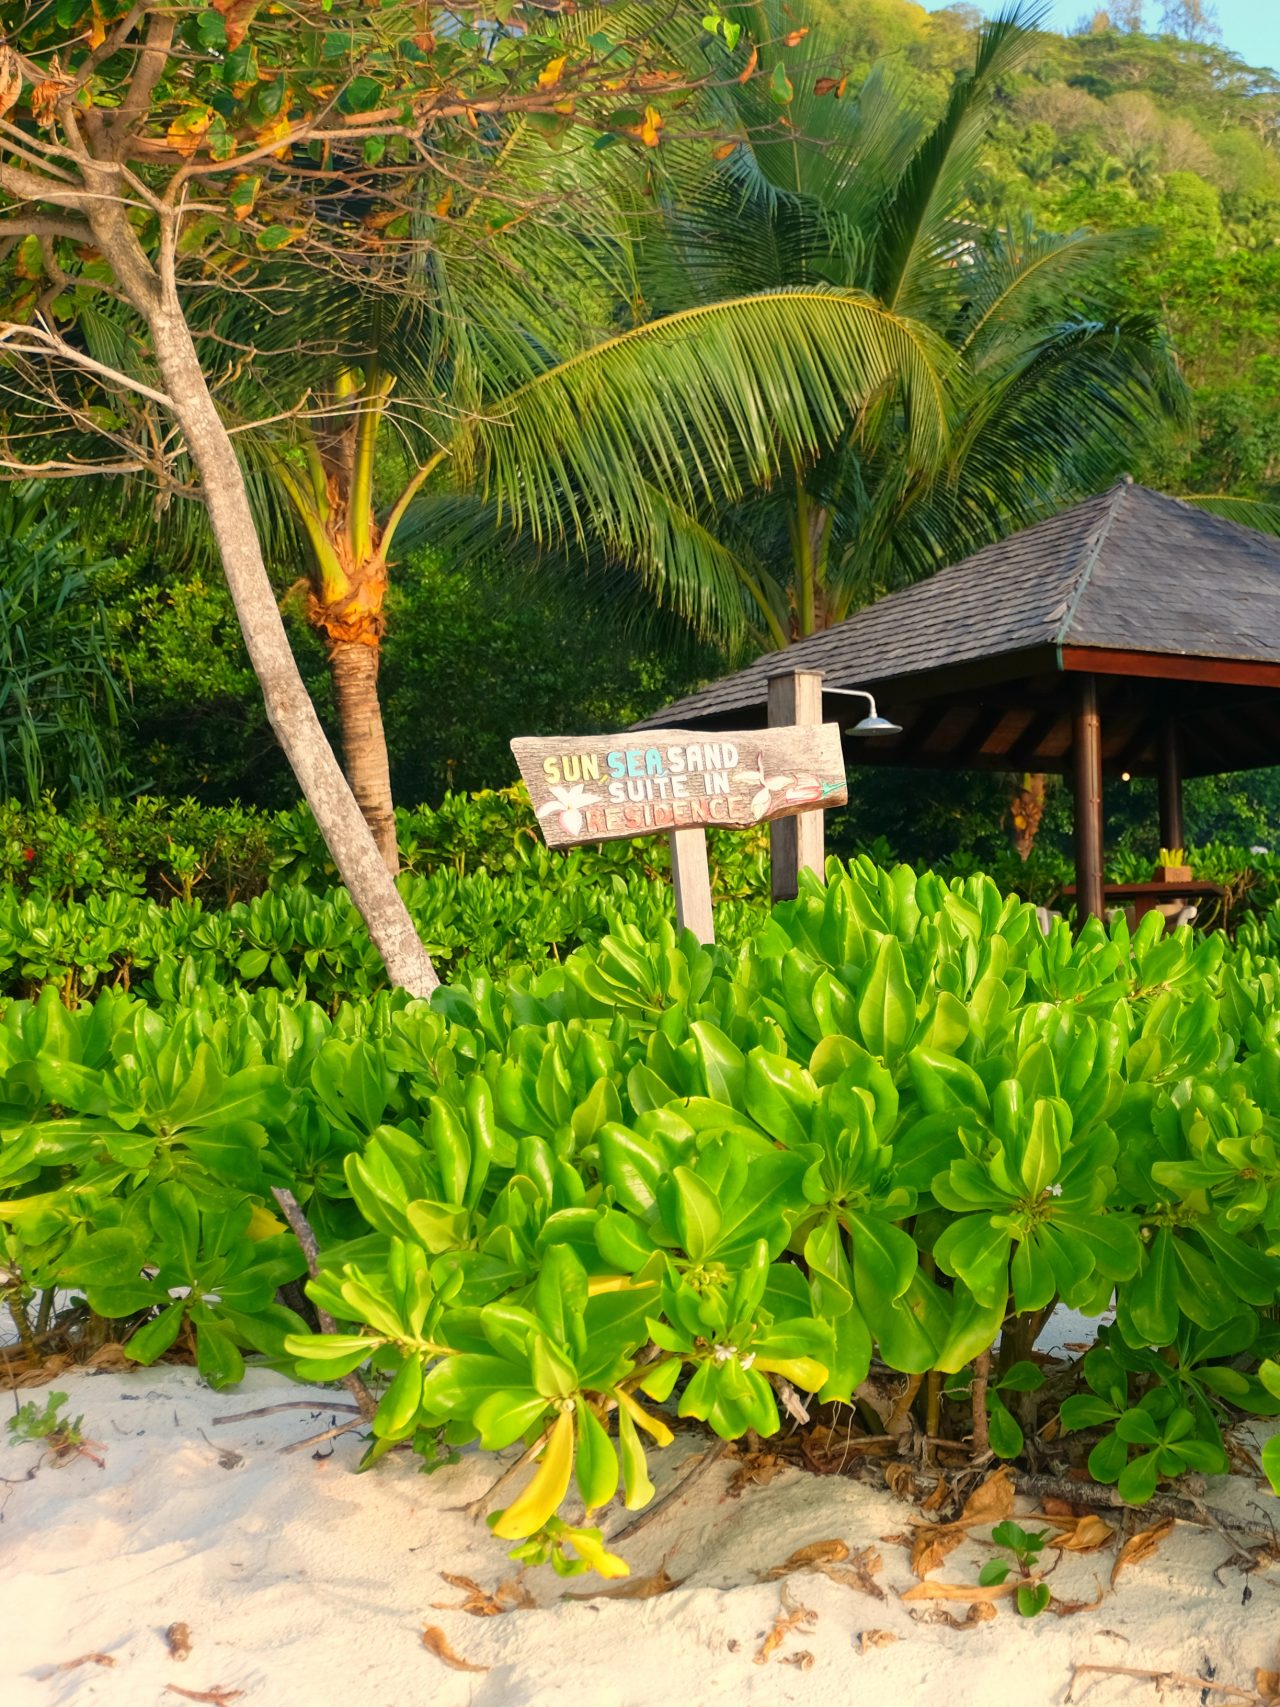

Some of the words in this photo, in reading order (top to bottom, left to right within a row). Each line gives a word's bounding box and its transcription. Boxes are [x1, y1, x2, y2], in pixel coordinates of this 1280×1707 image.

[667, 744, 738, 773] SAND
[609, 776, 689, 803] SUITE
[704, 772, 730, 796] IN
[585, 797, 744, 832] RESIDENCE
